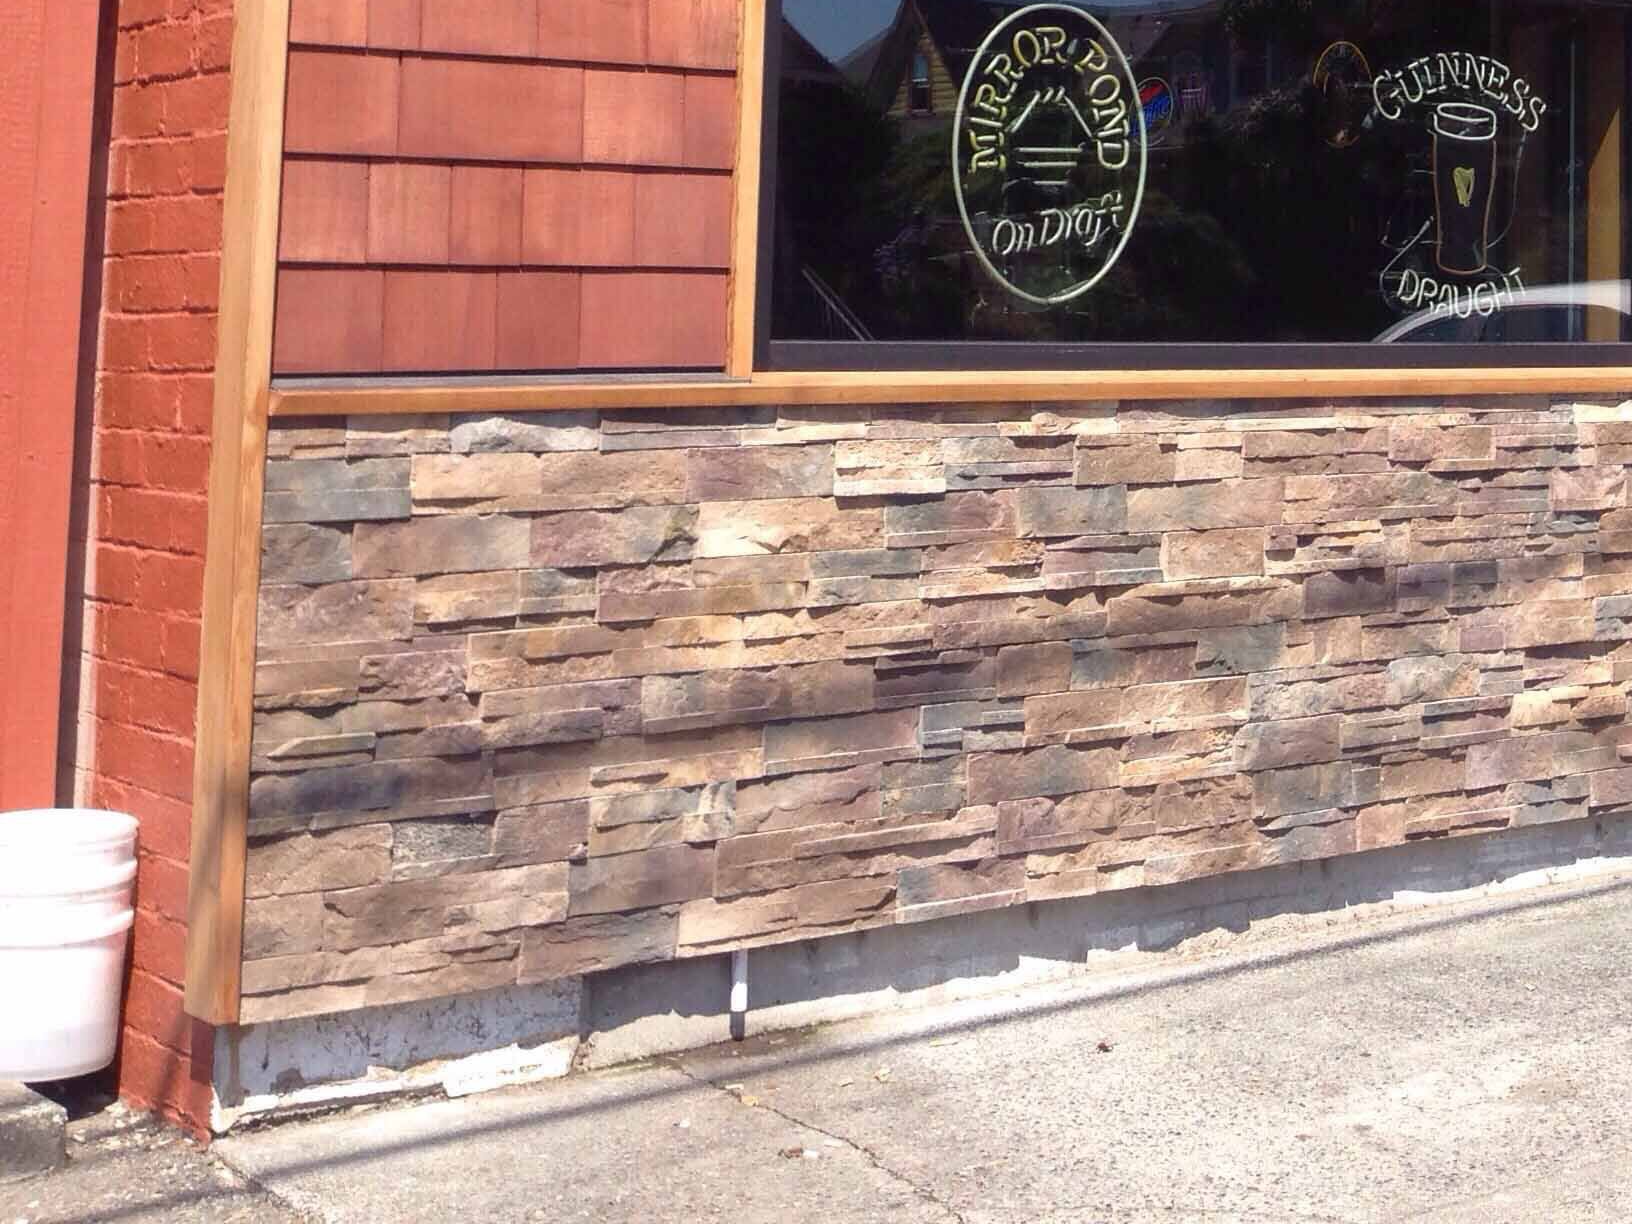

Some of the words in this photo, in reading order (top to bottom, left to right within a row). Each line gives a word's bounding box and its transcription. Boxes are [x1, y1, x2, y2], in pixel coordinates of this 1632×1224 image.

[968, 26, 1068, 174] MIRROR
[1074, 37, 1130, 170] POND
[1372, 51, 1547, 132] GUINNESS
[992, 218, 1034, 256] On
[1397, 266, 1527, 319] DRAUGHT
